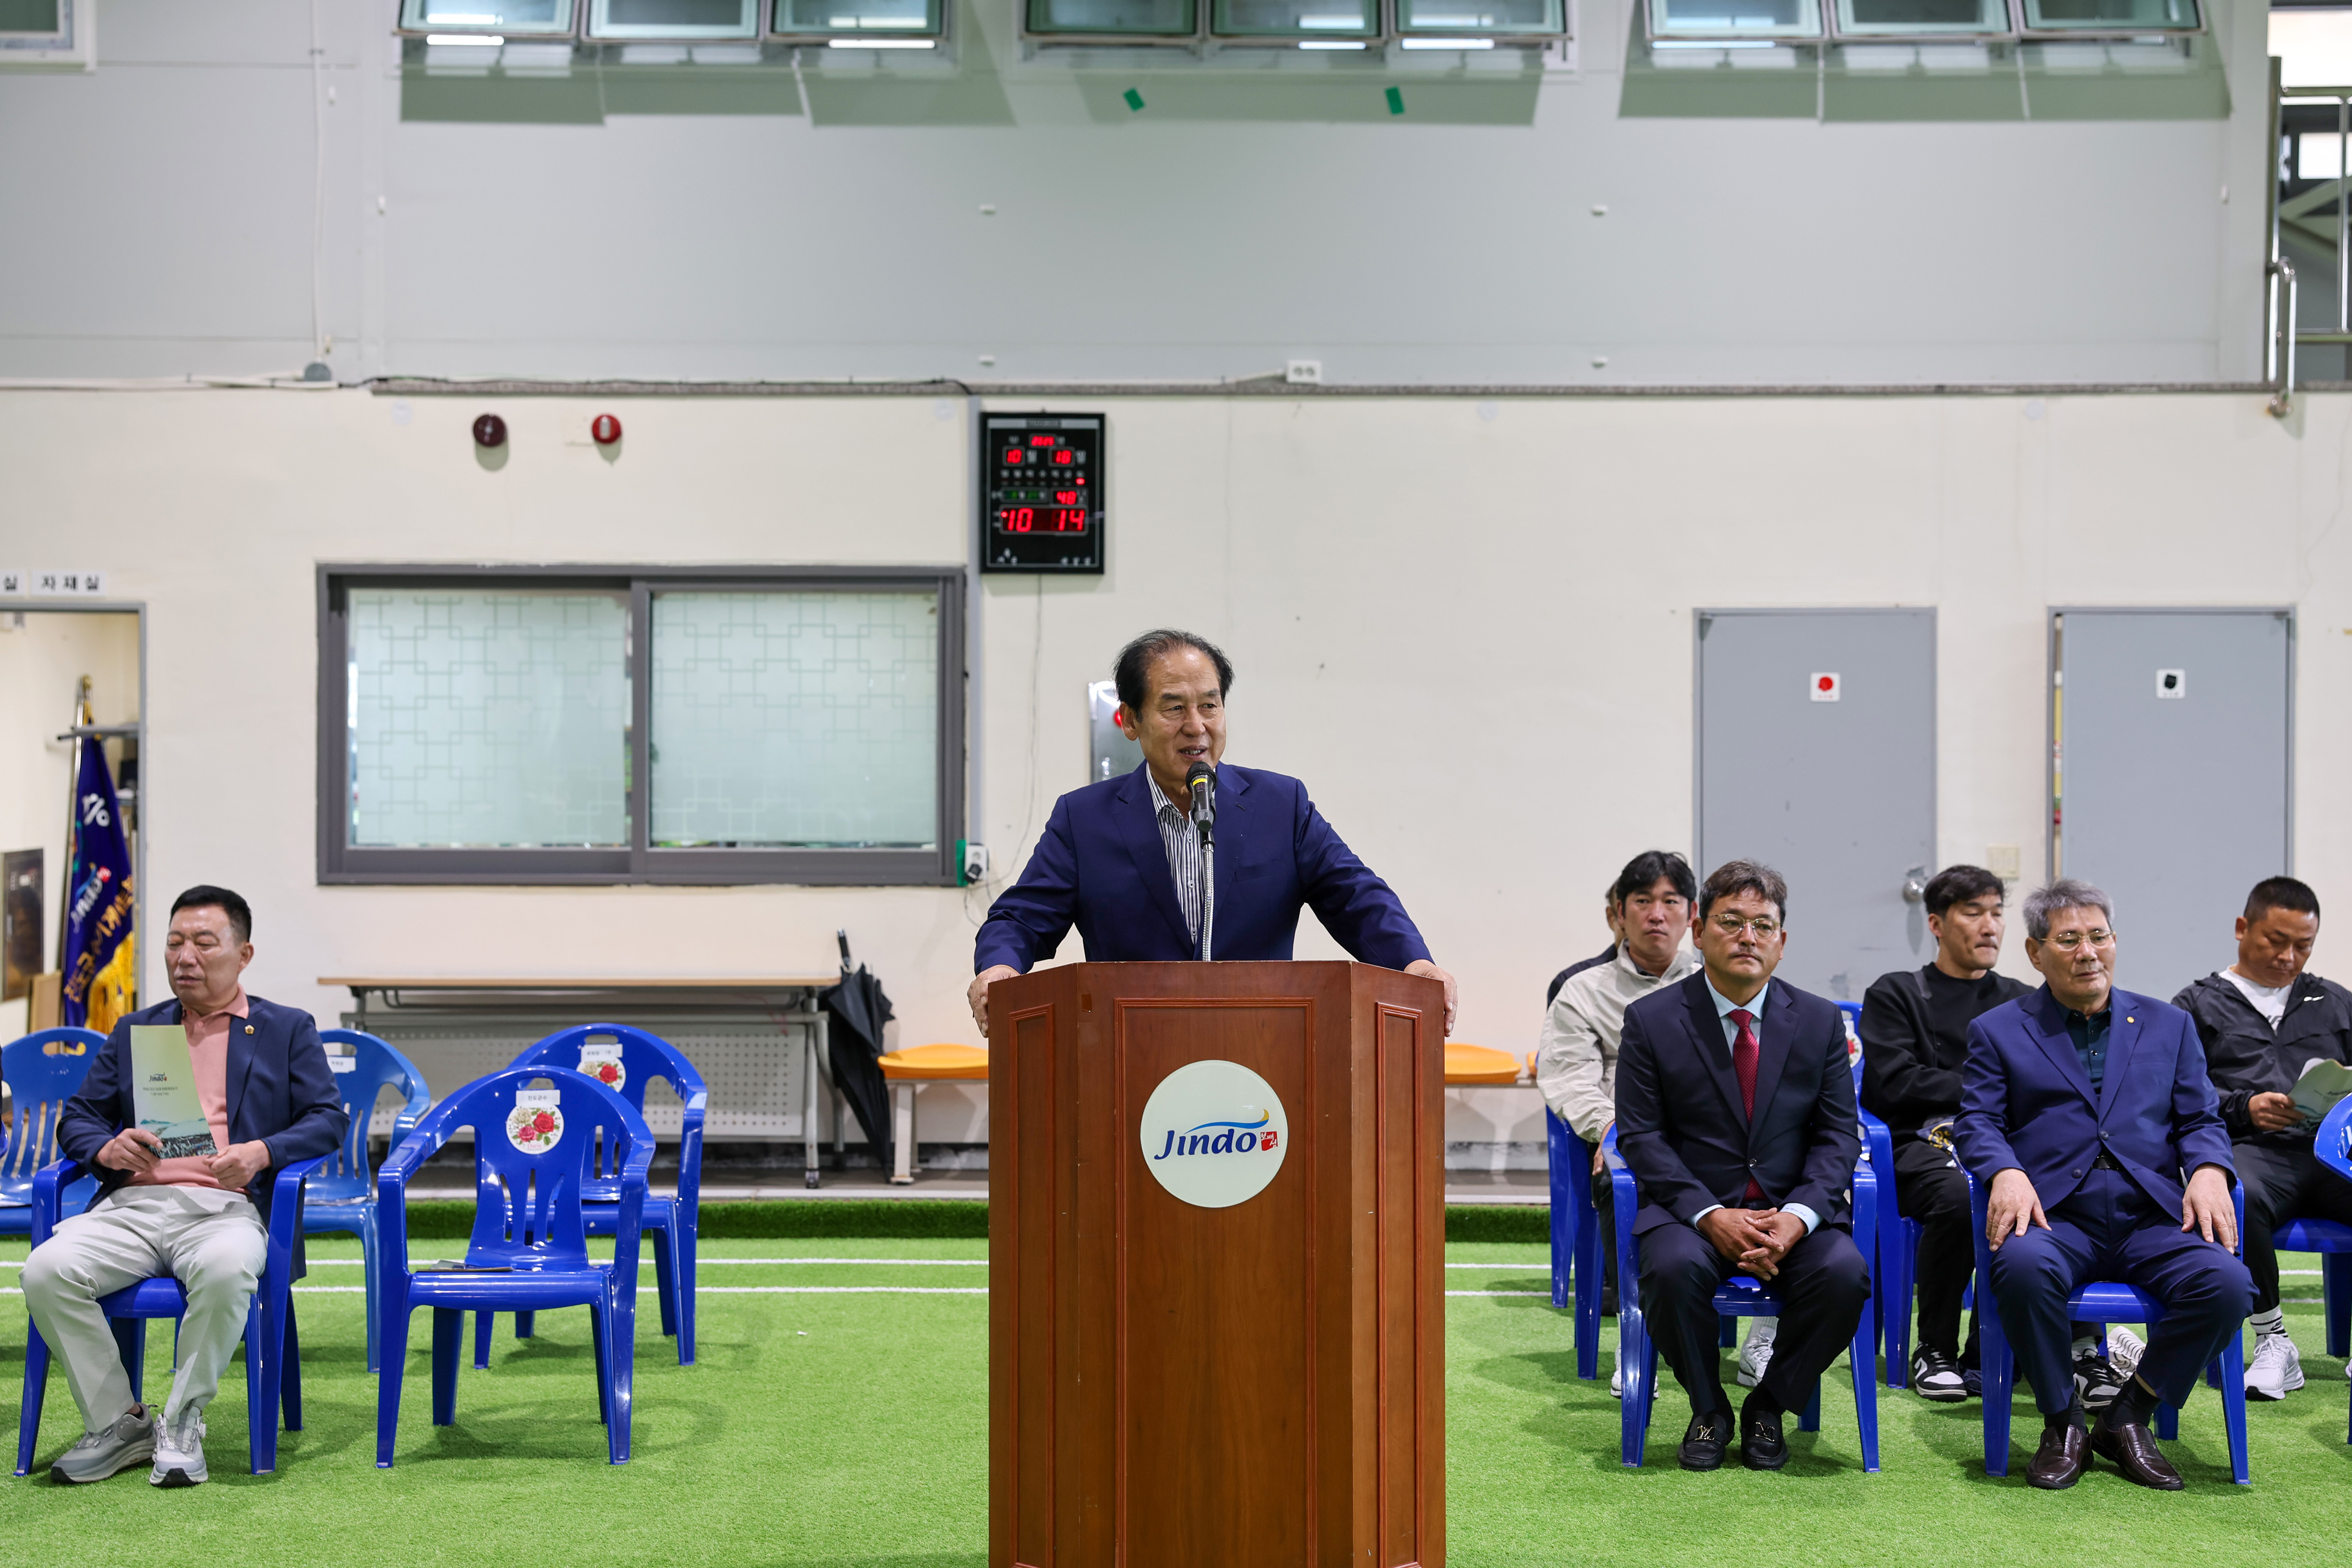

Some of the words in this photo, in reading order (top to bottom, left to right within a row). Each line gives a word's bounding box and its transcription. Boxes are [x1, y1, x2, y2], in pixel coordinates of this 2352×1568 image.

[1008, 508, 1033, 532] 10
[1058, 509, 1085, 531] 14
[1154, 1128, 1257, 1160] Jindo
